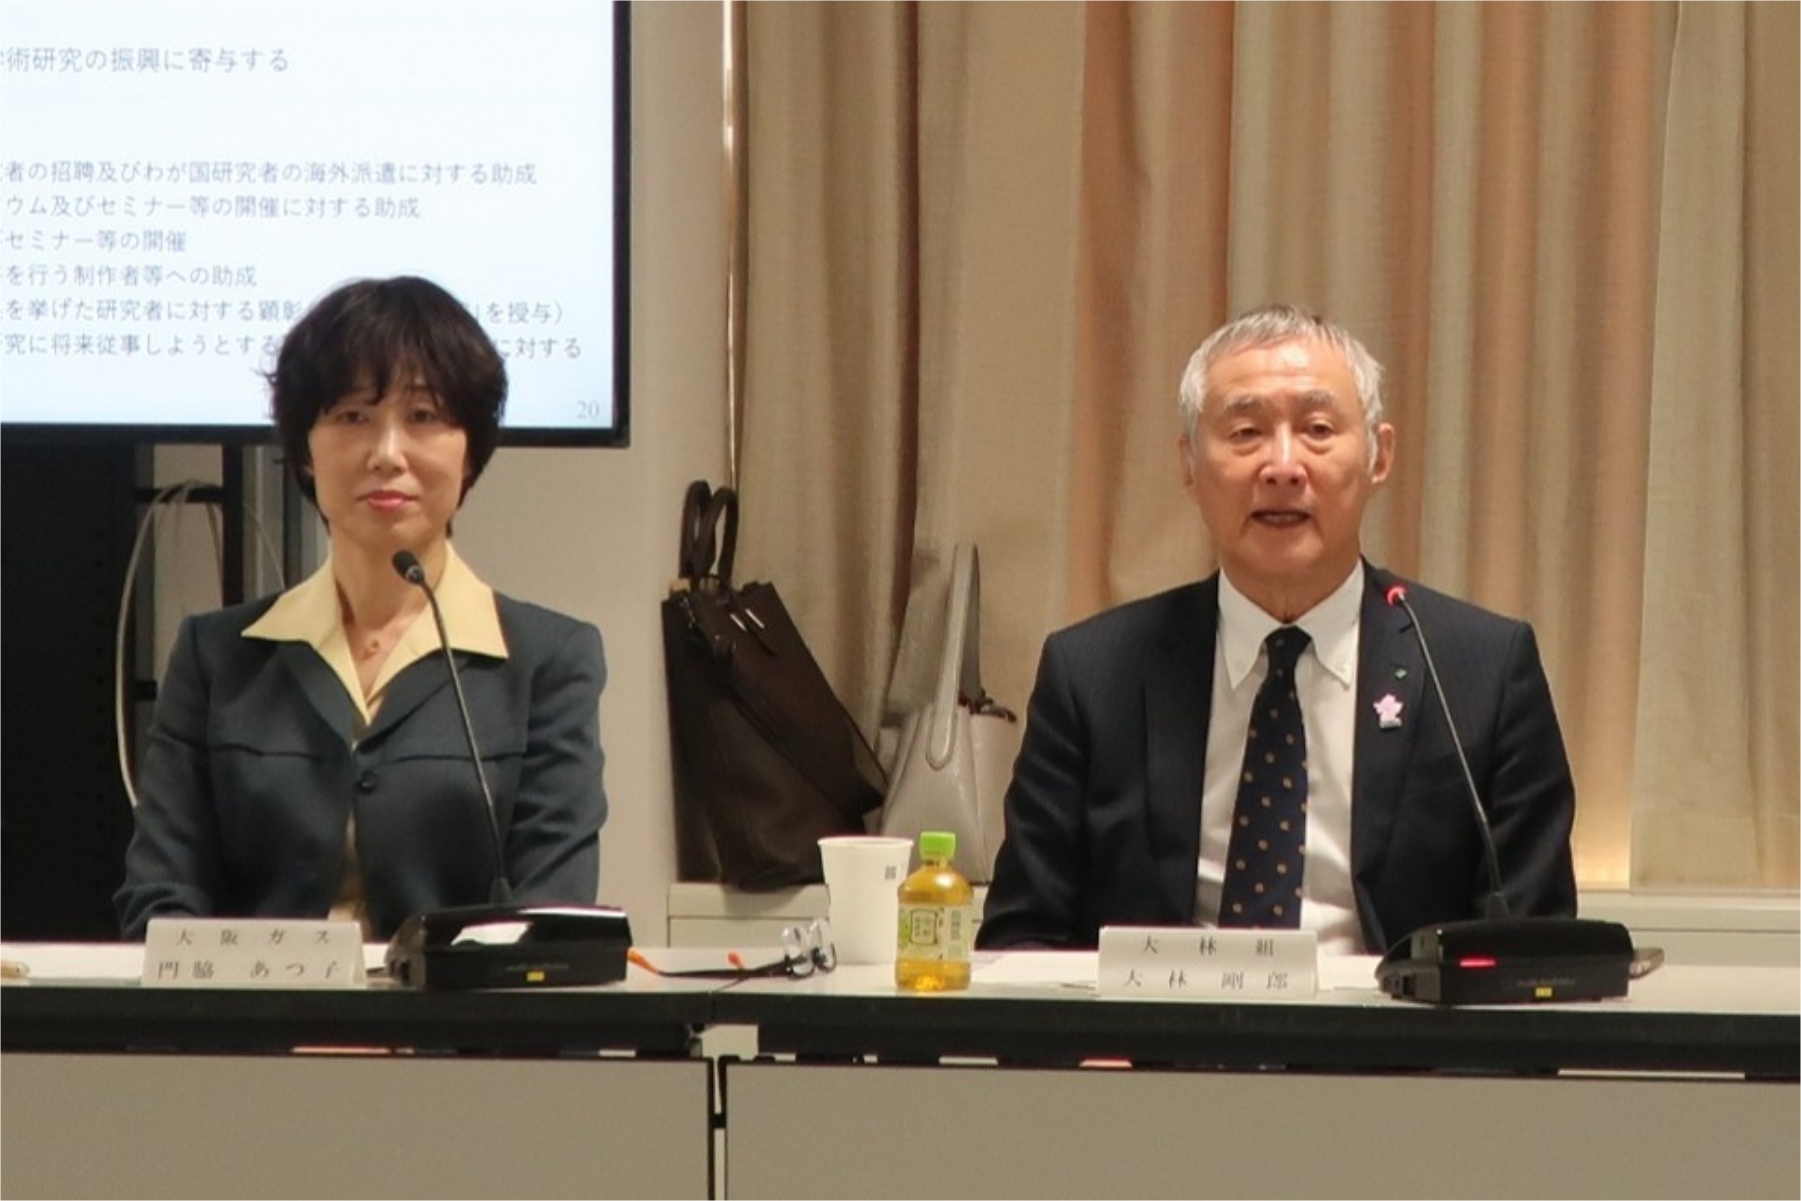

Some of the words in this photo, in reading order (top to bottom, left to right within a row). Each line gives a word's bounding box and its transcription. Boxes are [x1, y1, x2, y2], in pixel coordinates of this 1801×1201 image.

[0, 47, 289, 73] 術研究の振興に寄与する
[0, 160, 538, 185] 者の招聘及びわが国研究者の海外派遣に対する助成
[0, 195, 421, 219] ウム及びセミナー等の開催に対する助成
[0, 229, 187, 252] セミナー等の開催
[0, 264, 258, 288] を行う制作者等への助成
[0, 298, 302, 322] を挙げた研究者に対する顕彰
[0, 333, 277, 357] 究に将来従事しようとする
[577, 399, 600, 419] 20
